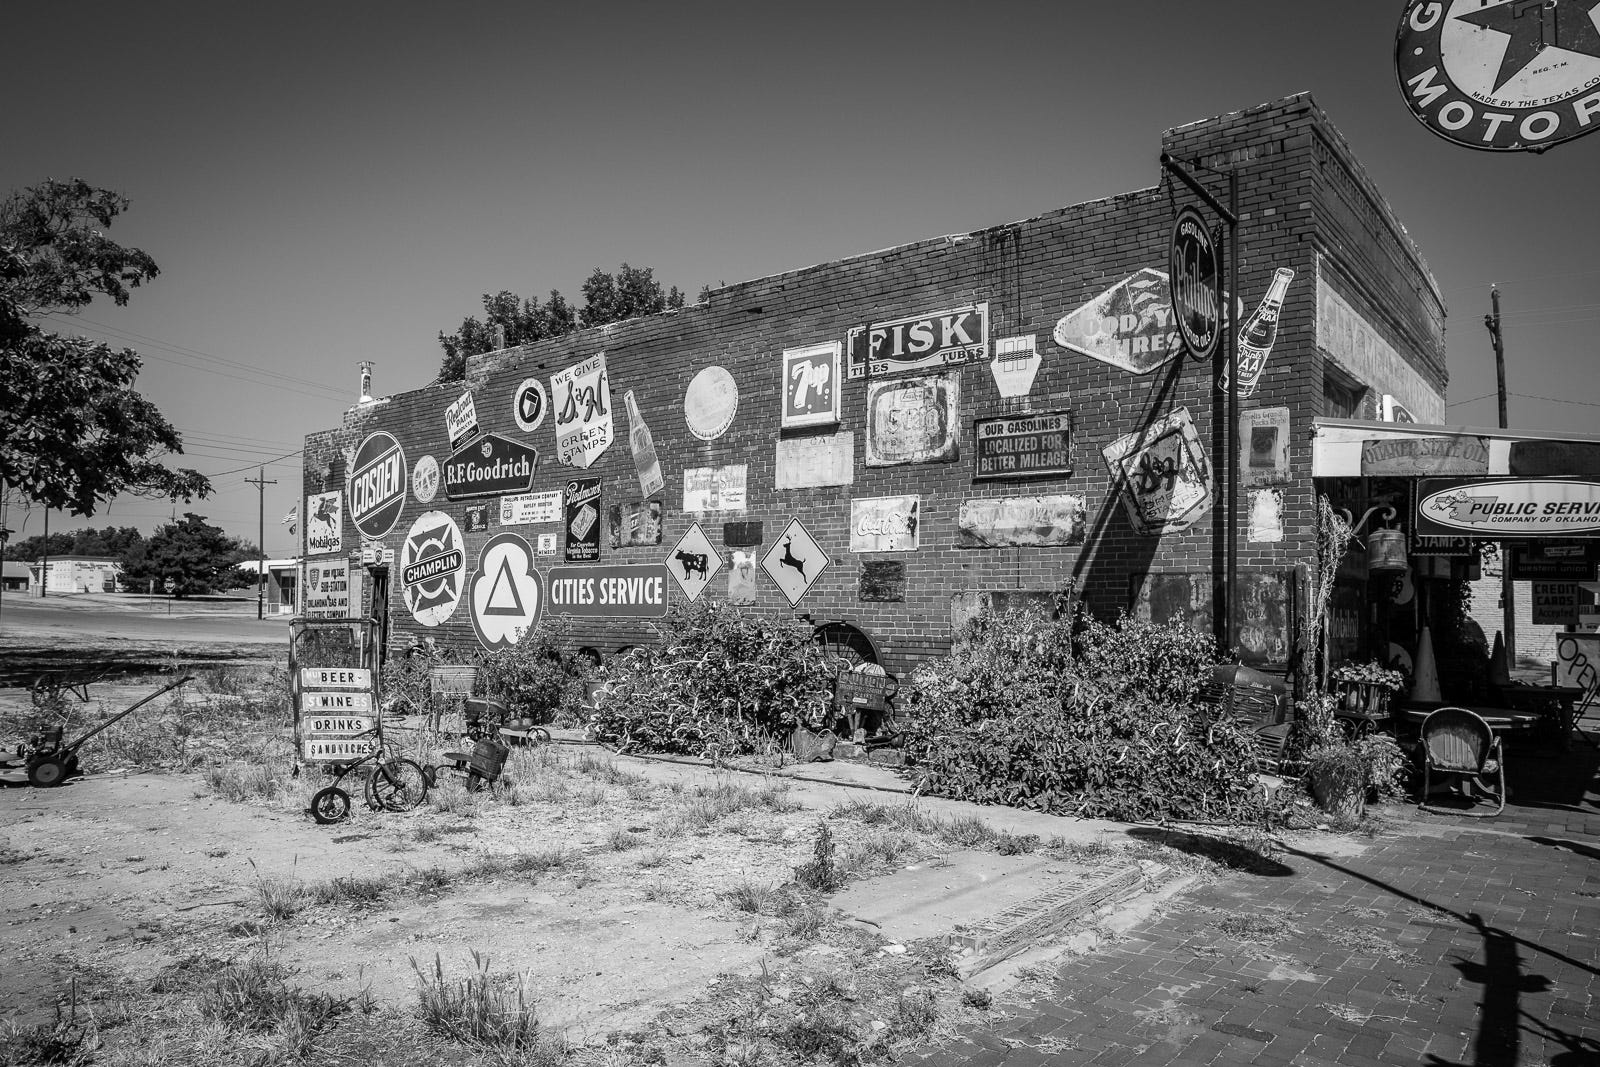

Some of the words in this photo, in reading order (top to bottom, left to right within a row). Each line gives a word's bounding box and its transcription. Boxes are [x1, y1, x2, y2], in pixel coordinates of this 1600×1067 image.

[1471, 91, 1497, 107] MADE
[1518, 99, 1538, 107] THE
[1542, 87, 1579, 103] TEXAS
[1583, 73, 1600, 88] CO
[1180, 222, 1209, 255] GASOLINE
[1174, 240, 1216, 332] Phillips
[863, 312, 973, 361] FISK
[1200, 330, 1211, 348] OILS
[554, 372, 572, 386] WE
[574, 358, 600, 377] GIVE
[455, 408, 473, 428] PAINT
[985, 423, 1004, 437] OUR
[1007, 417, 1061, 434] GASOLINES
[453, 420, 473, 437] PRODUCTS
[562, 422, 608, 448] GREEN
[563, 436, 608, 458] STAMPS
[984, 436, 1038, 455] LOCALIZED
[1041, 433, 1063, 450] FOR
[1364, 440, 1419, 465] QUAKER
[1423, 440, 1463, 458] STATE
[1463, 443, 1486, 464] OIL
[981, 455, 1016, 472] BETTER
[1019, 451, 1067, 468] MILEAGE
[353, 450, 400, 518] COSDEN
[1469, 502, 1538, 515] PUBLIC
[309, 536, 340, 551] Mobilgas
[1414, 536, 1466, 549] STAMPS
[407, 554, 458, 582] CHAMPLIN
[1560, 565, 1587, 573] union
[551, 577, 594, 605] CITIES
[599, 577, 662, 604] SERVICE
[1534, 583, 1577, 595] CREDIT
[307, 599, 328, 608] OKLAHOMA
[328, 598, 337, 607] GAS
[338, 597, 347, 606] AND
[1537, 595, 1574, 606] CARDS
[307, 610, 326, 619] ELECTRIC
[327, 609, 347, 619] COMPANY
[1537, 607, 1575, 618] Accepted
[1558, 638, 1598, 692] OPEN
[321, 672, 355, 683] BEER
[321, 697, 353, 707] WINE
[315, 719, 362, 730] DRINKS
